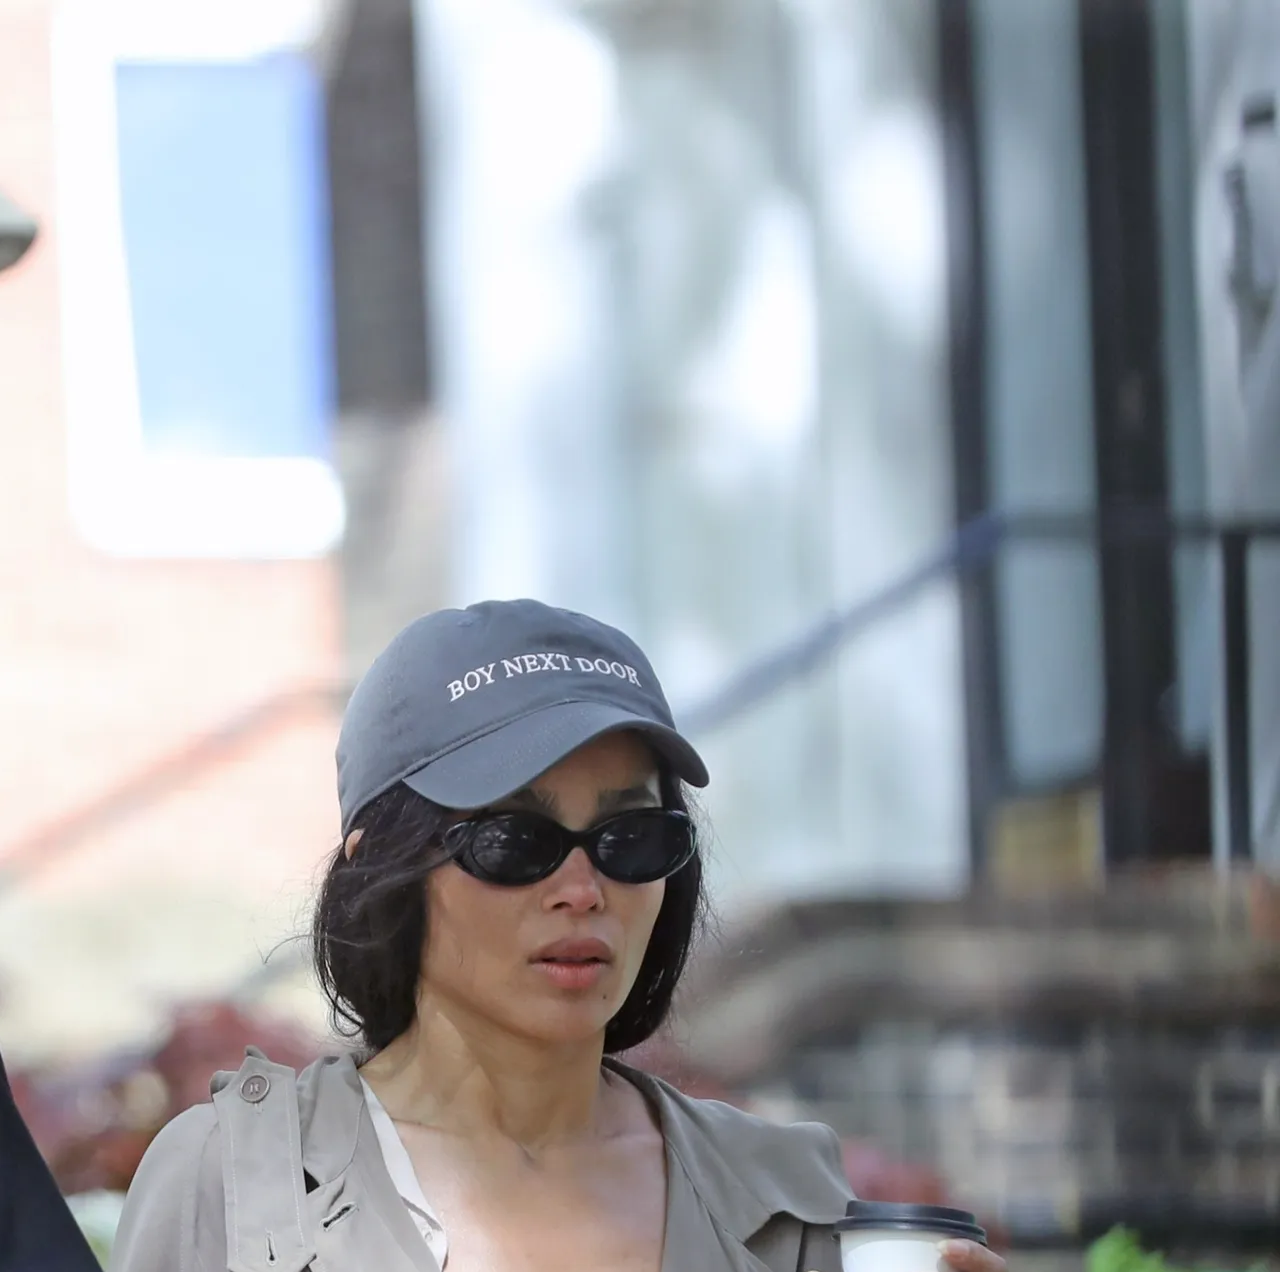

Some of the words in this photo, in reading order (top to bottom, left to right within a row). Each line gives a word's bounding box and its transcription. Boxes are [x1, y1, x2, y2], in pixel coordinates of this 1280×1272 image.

[447, 663, 496, 702] BOY
[501, 653, 572, 678] NEXT
[575, 657, 642, 687] DOOR
